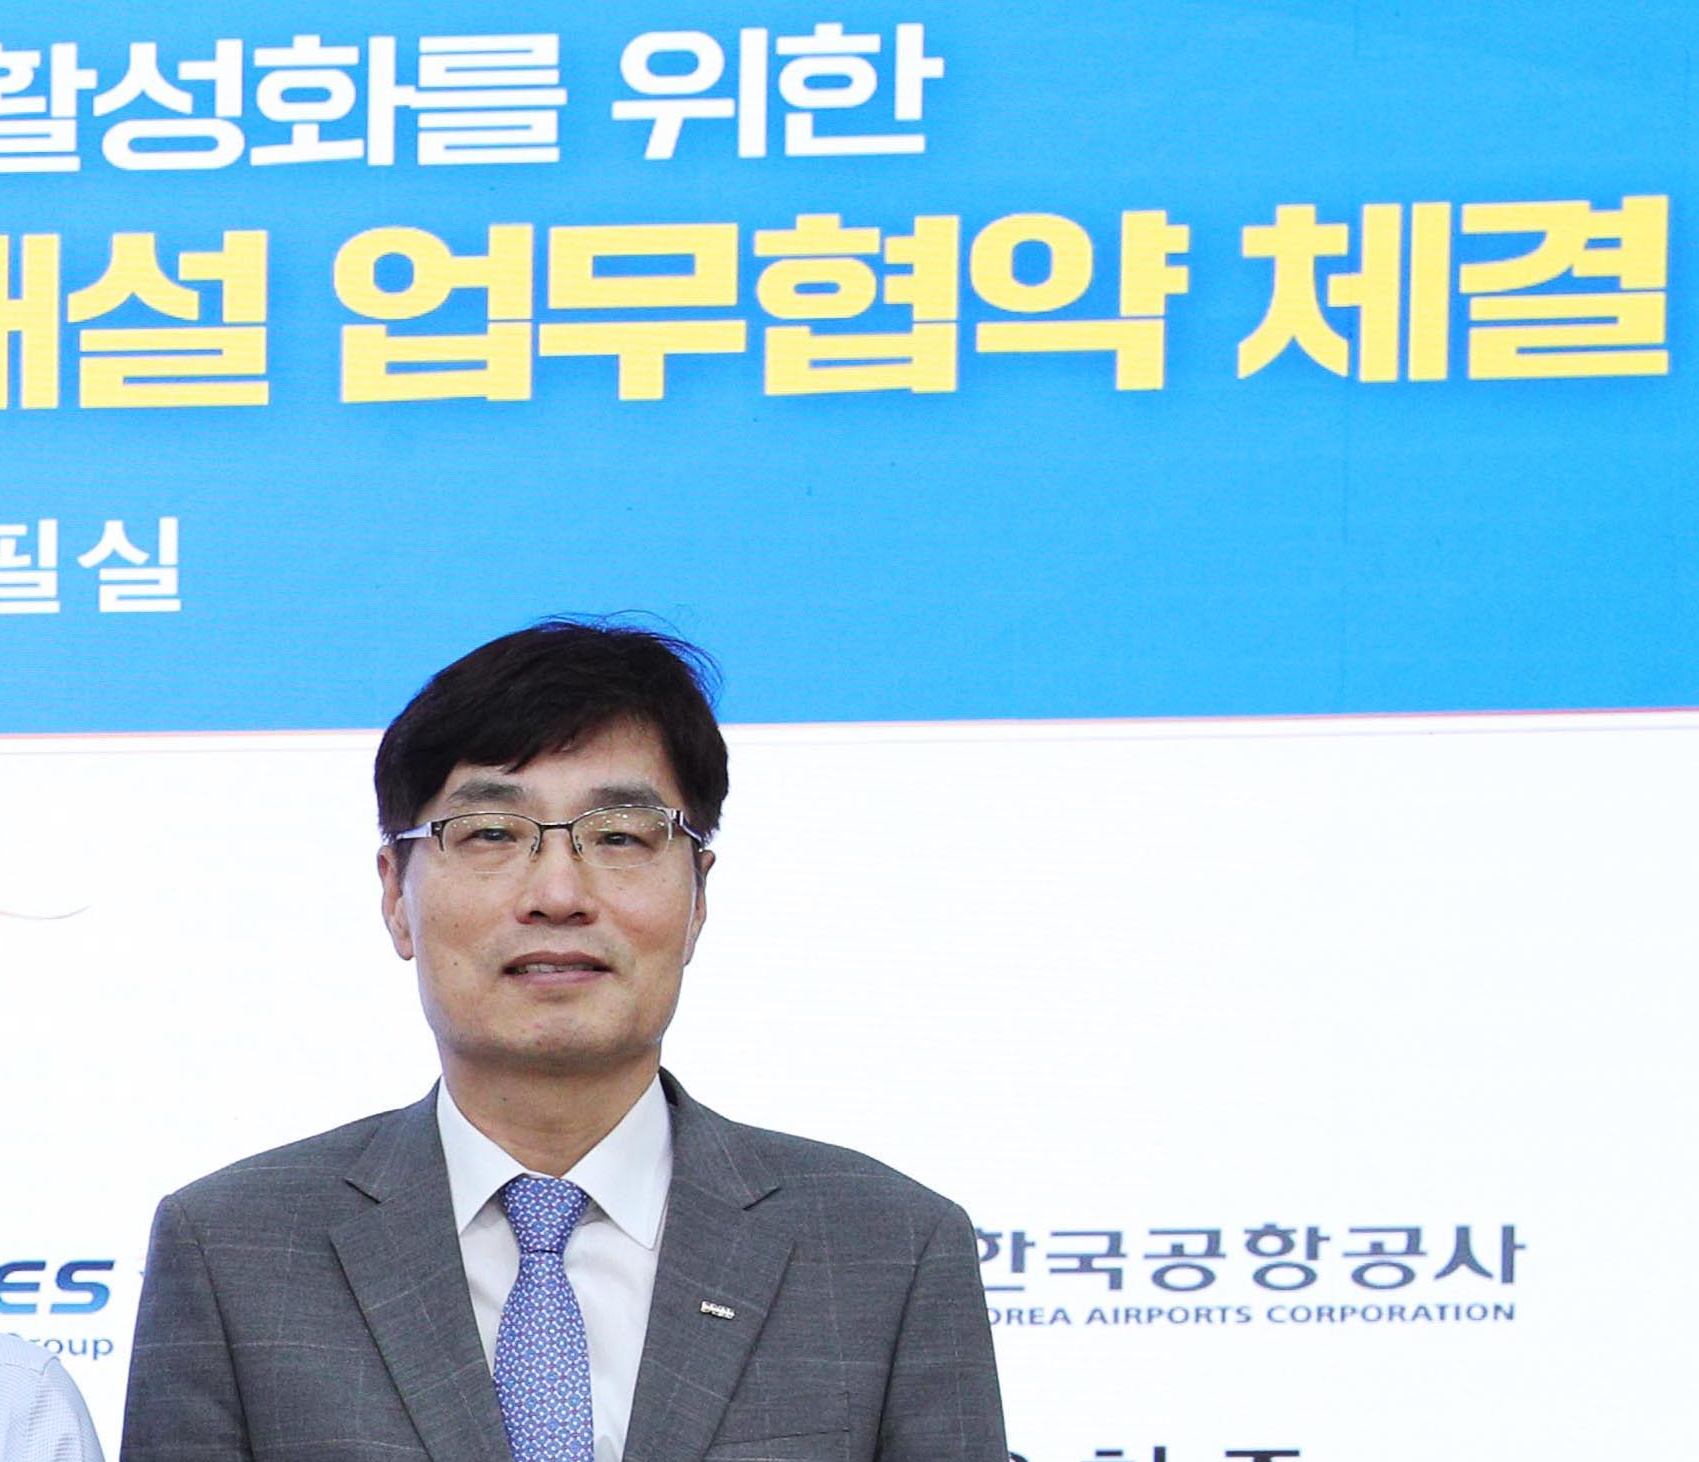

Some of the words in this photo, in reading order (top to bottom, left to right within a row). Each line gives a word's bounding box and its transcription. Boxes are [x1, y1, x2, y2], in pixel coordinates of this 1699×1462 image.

[613, 24, 944, 158] 위한
[334, 211, 1189, 402] 업무협약
[1238, 195, 1669, 382] 체결
[987, 1307, 1072, 1326] OREA
[1085, 1305, 1253, 1325] AIRPORTS
[1266, 1303, 1516, 1324] CORPORATION
